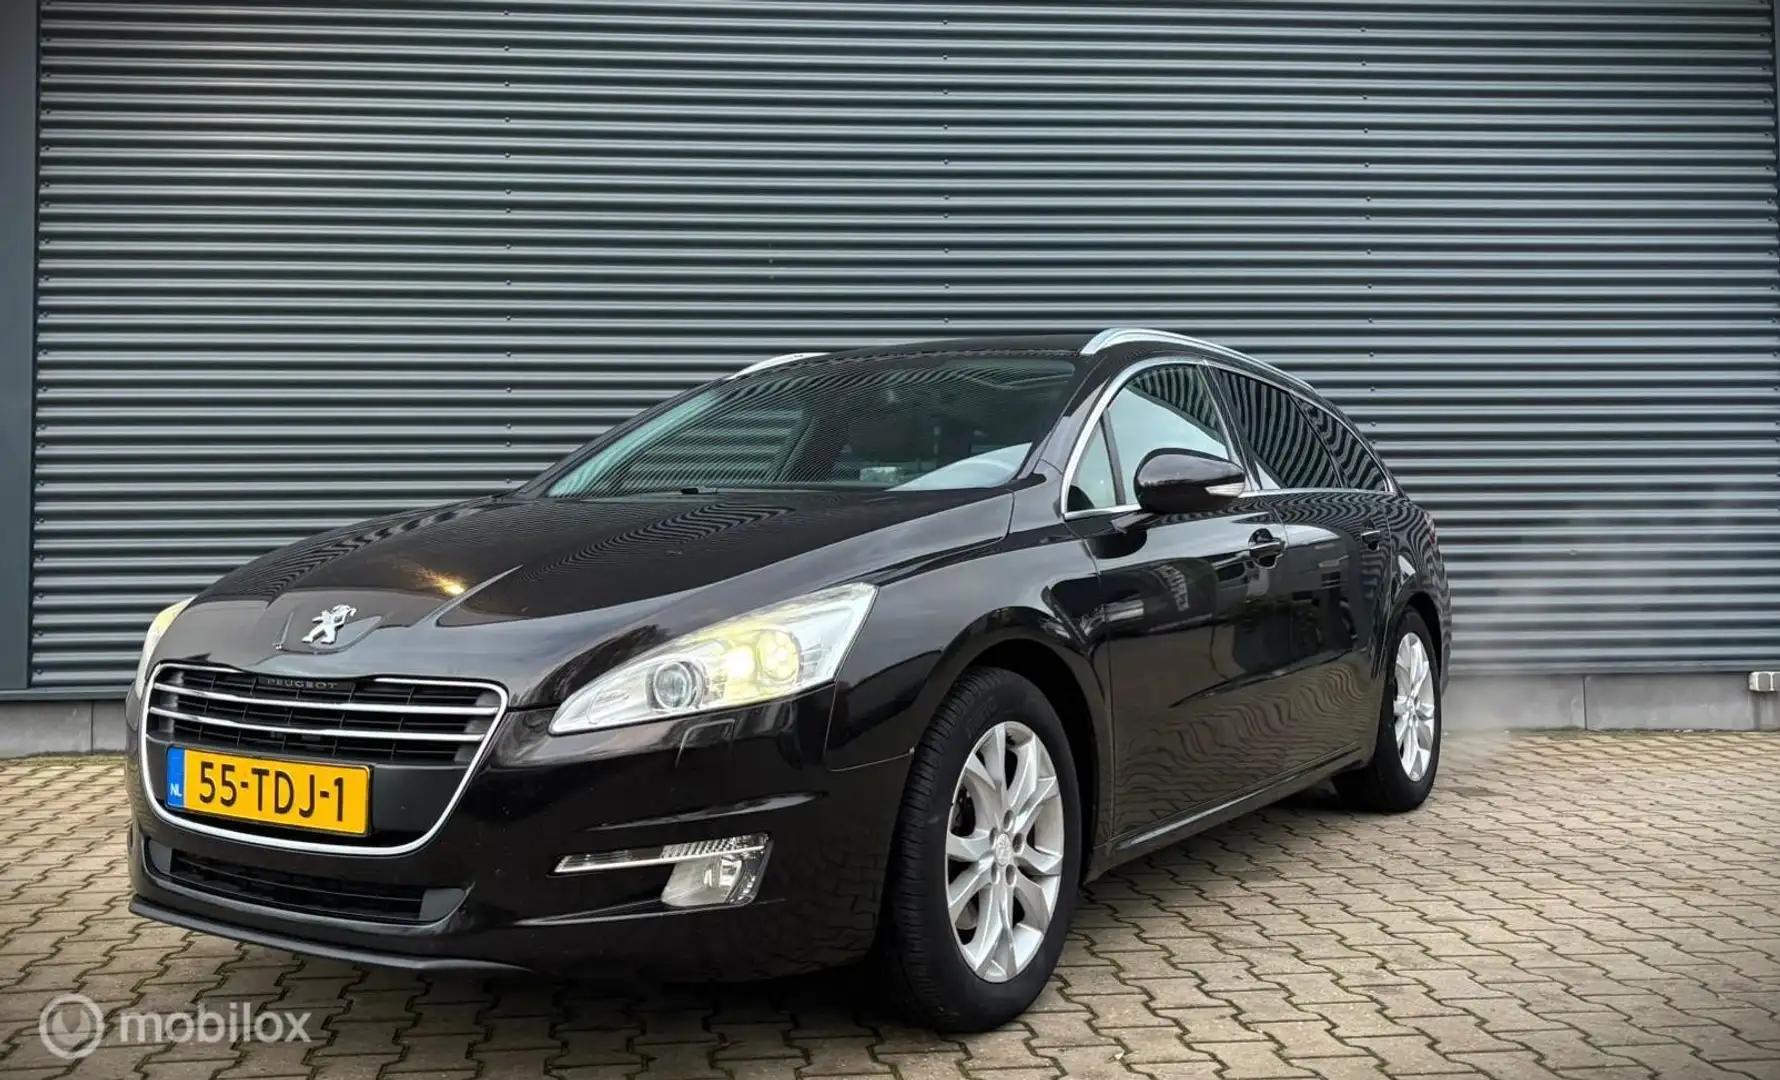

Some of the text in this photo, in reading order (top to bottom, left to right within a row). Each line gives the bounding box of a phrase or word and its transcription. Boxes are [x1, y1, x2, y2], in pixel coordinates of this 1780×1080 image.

[266, 678, 338, 689] PEUGEOT
[170, 783, 183, 797] NL
[199, 760, 344, 822] 55-TDJ-1
